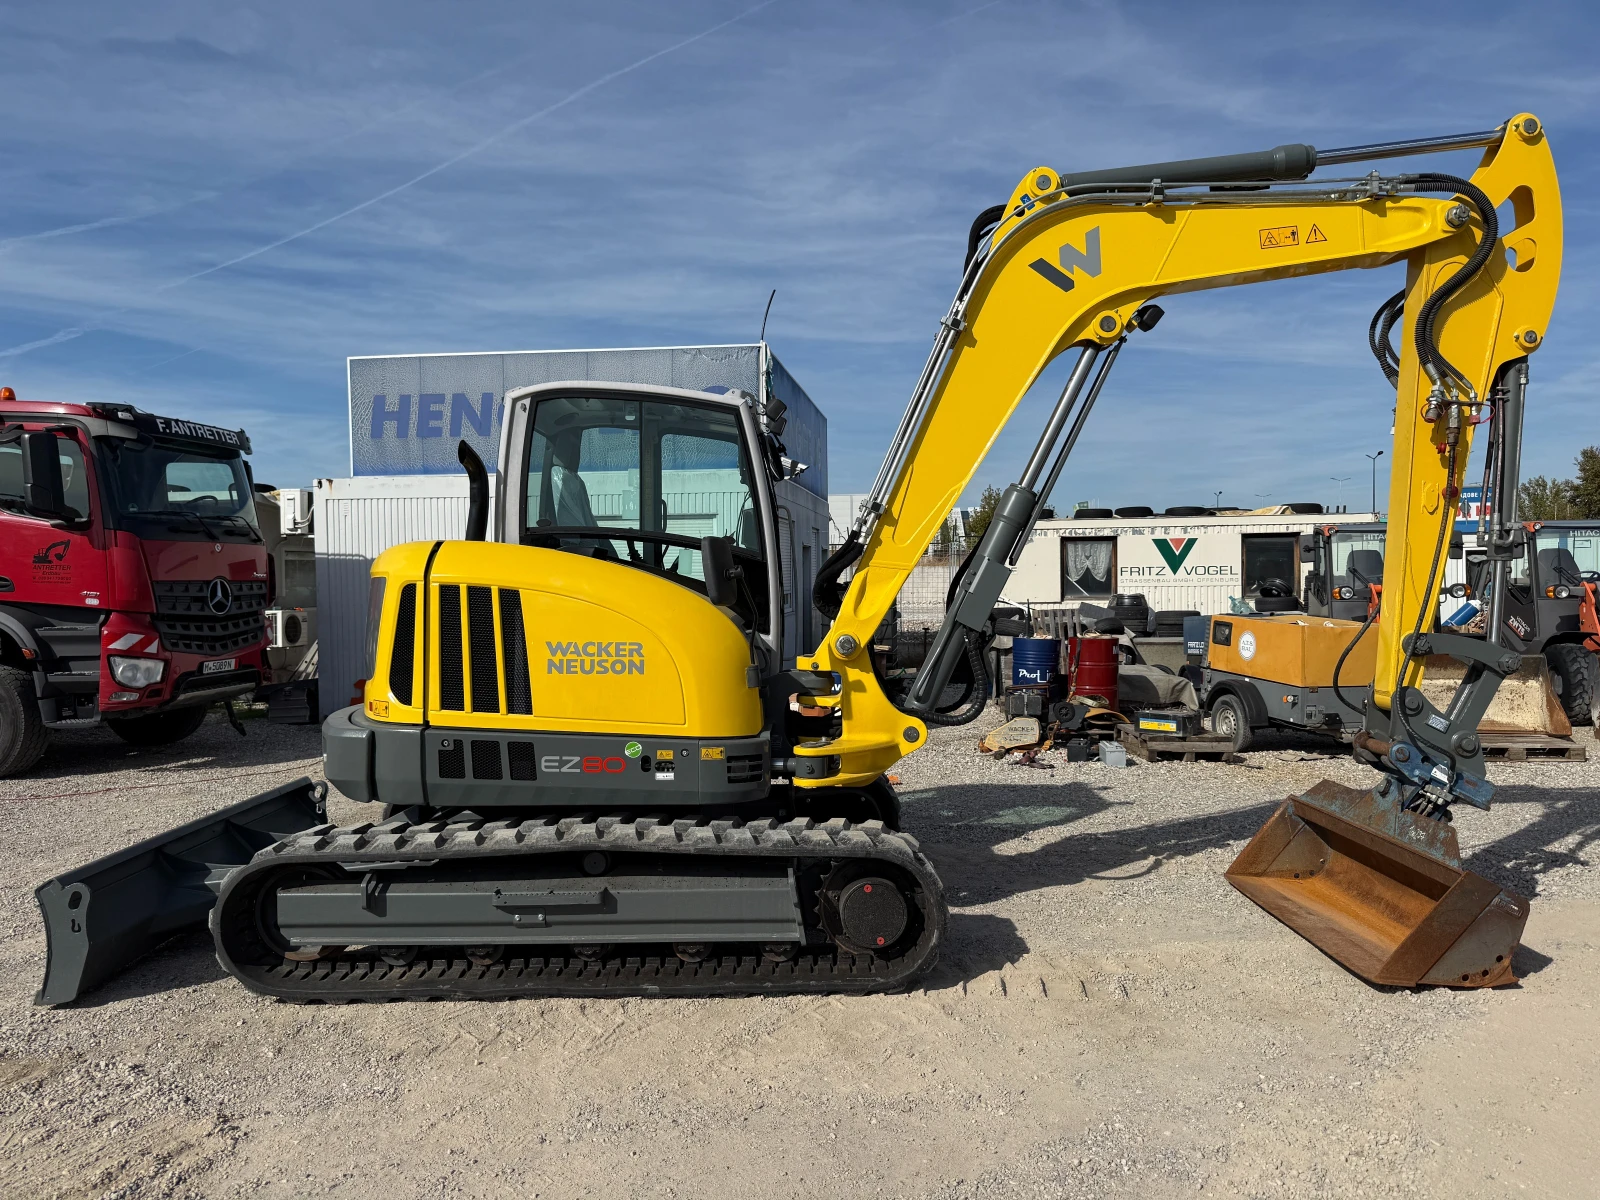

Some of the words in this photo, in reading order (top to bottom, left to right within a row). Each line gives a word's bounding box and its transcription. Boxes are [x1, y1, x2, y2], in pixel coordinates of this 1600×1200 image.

[1120, 566, 1166, 576] FRITZ
[1183, 565, 1238, 576] VOGEL
[545, 641, 645, 658] WACKER
[546, 658, 645, 675] NEUSON
[540, 755, 626, 774] EZ80
